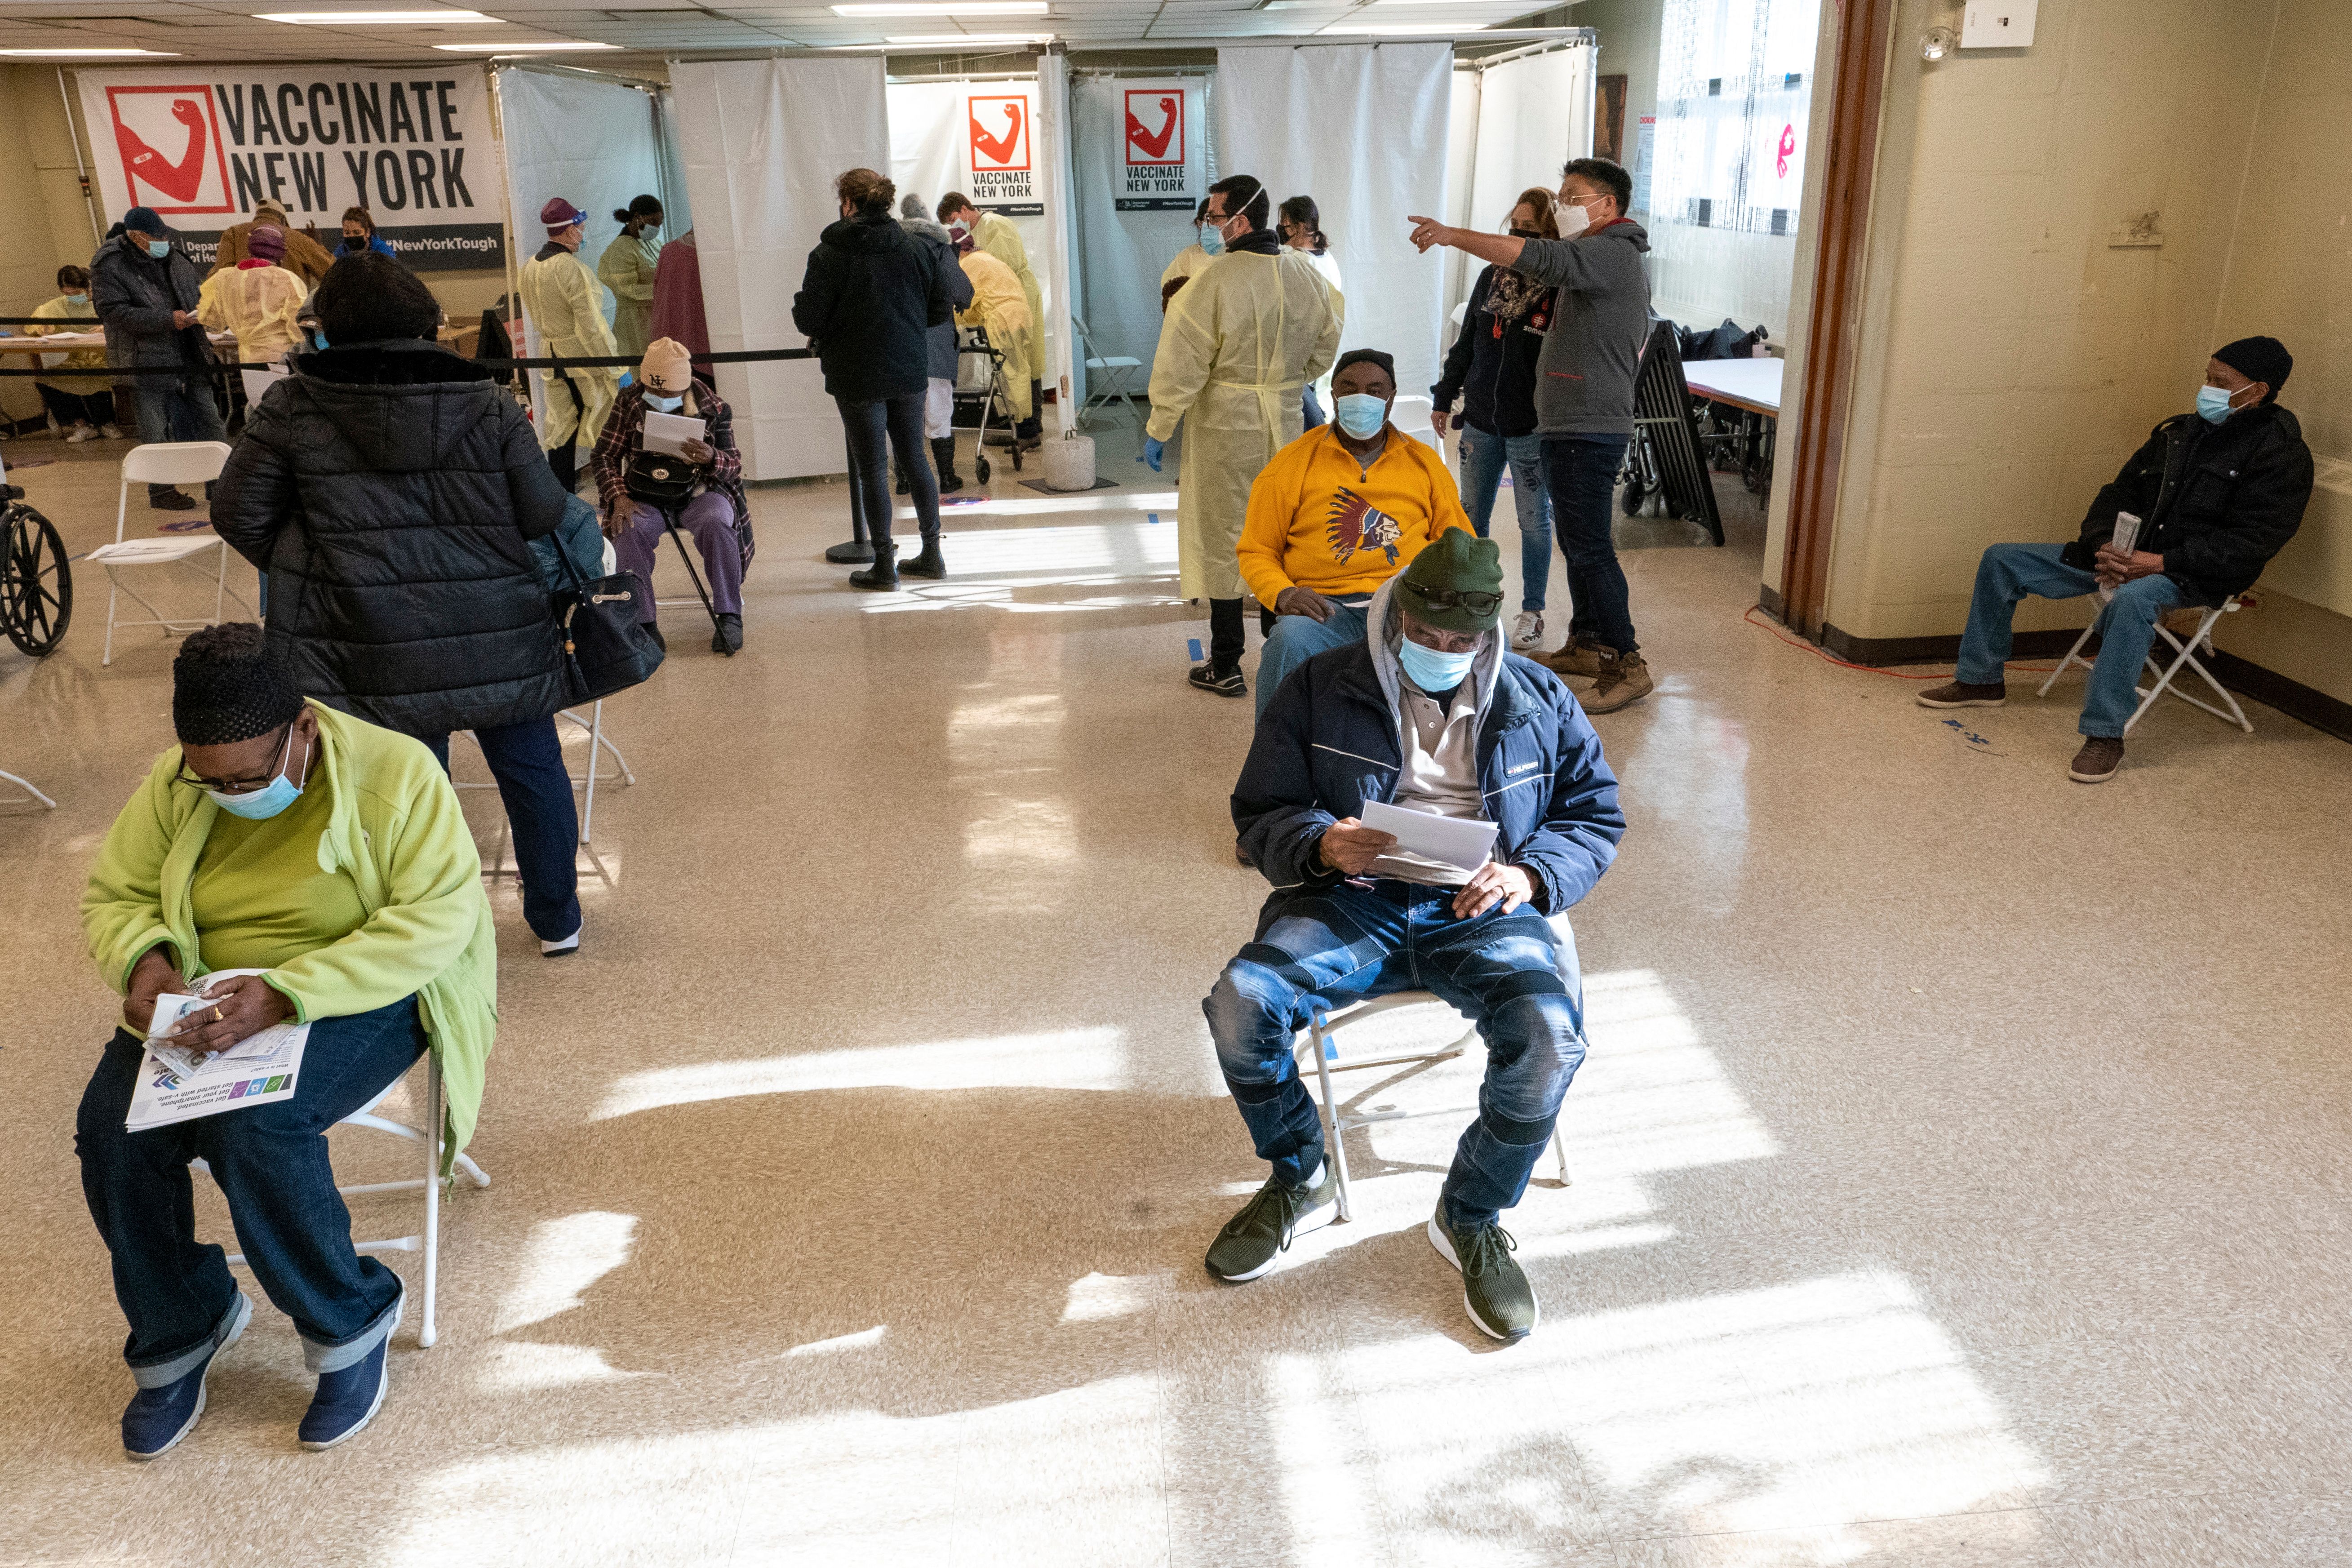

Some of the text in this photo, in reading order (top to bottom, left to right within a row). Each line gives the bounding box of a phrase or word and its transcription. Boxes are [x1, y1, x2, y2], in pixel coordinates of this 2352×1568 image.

[216, 81, 463, 146] VACCINATE
[973, 172, 1031, 184] VACCINATE
[1127, 166, 1185, 178] VACCINATE
[232, 148, 474, 213] NEW YORK
[1127, 179, 1185, 191] NEW YORK
[974, 185, 1032, 198] NEW YORK
[187, 241, 219, 253] Depar
[190, 253, 200, 263] of
[1513, 761, 1538, 773] HILFIGER
[197, 1084, 221, 1094] started
[157, 1093, 179, 1102] v-safe.
[160, 1094, 201, 1107] smartphone.
[177, 1098, 213, 1110] vaccinated.
